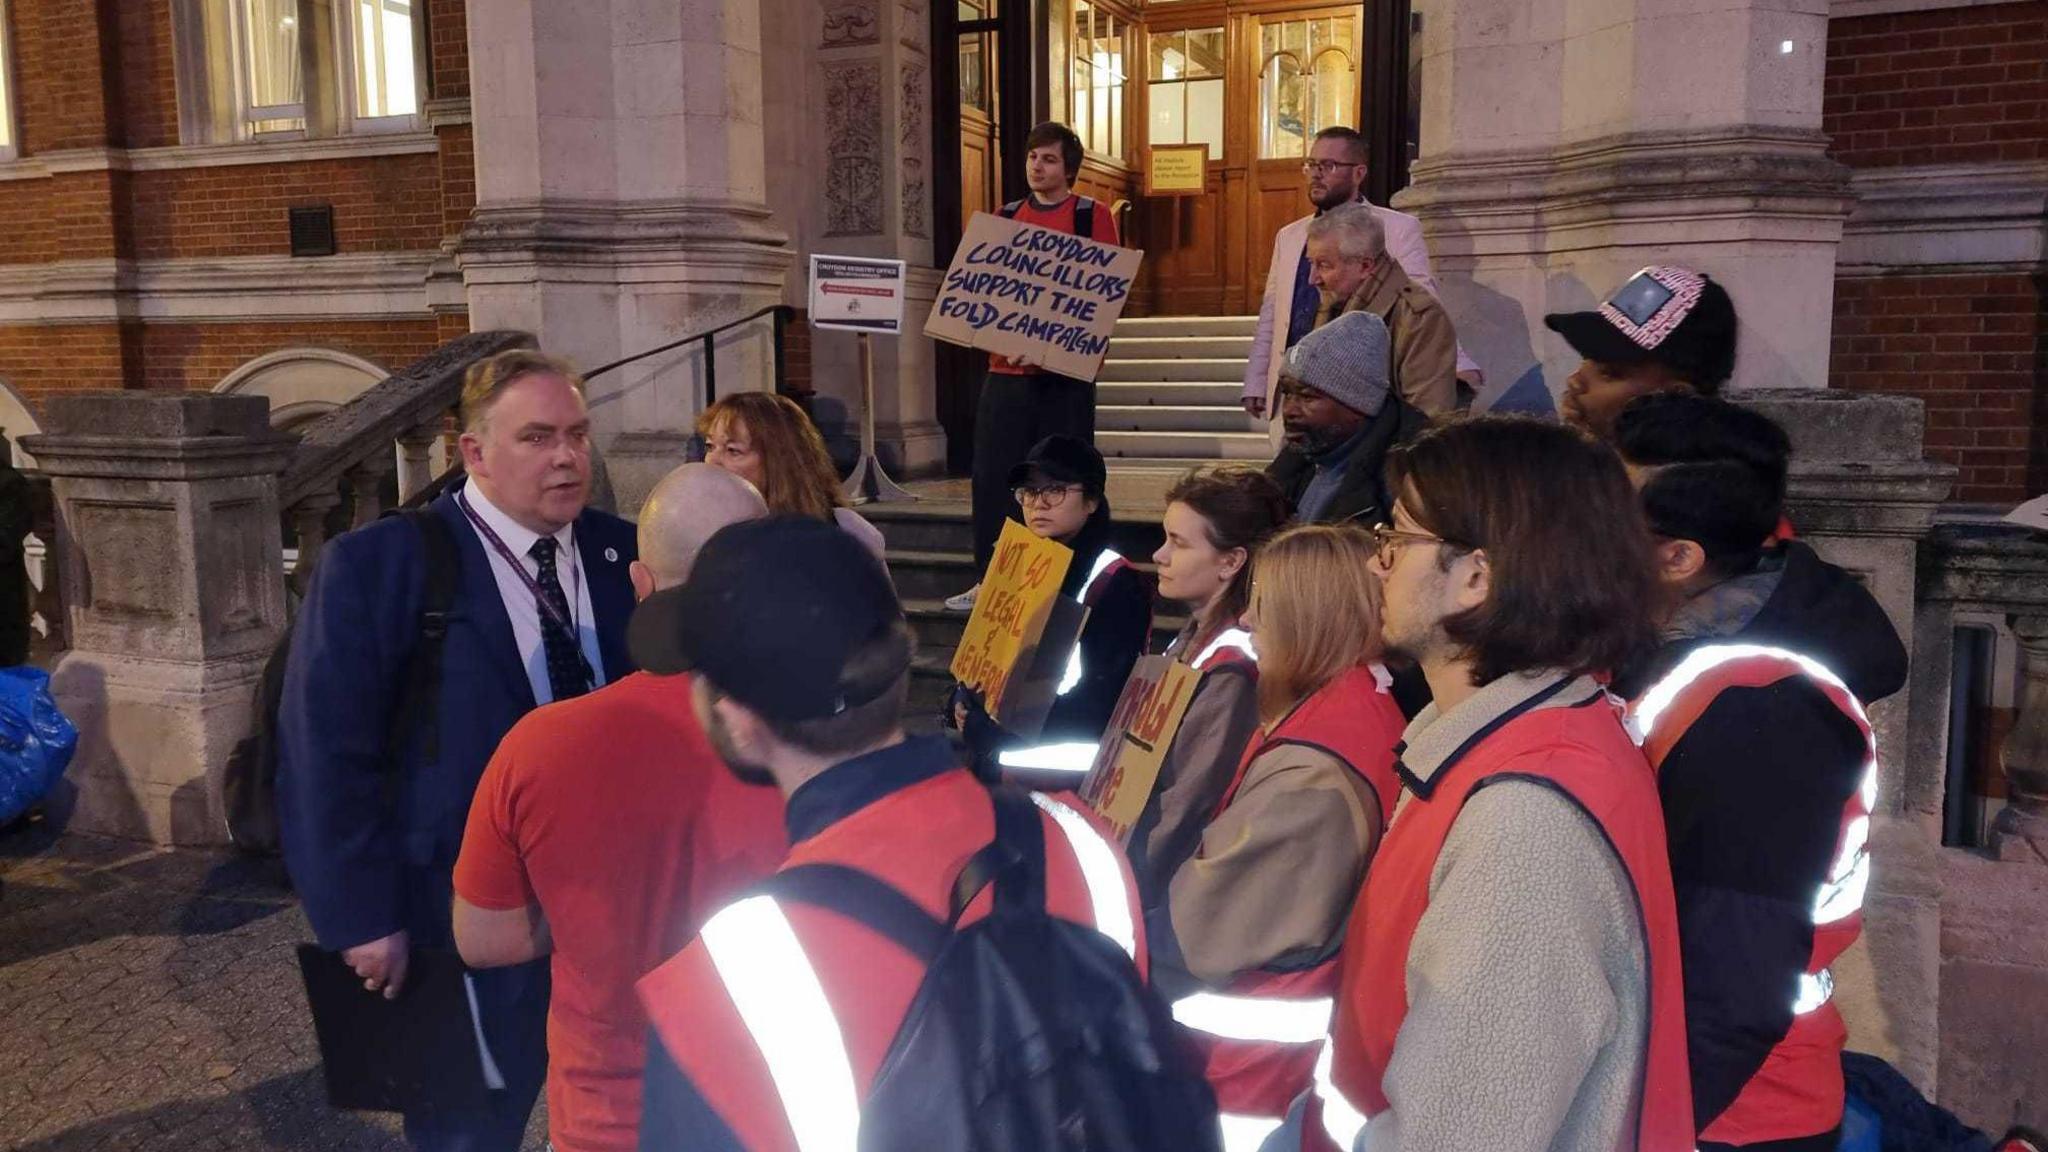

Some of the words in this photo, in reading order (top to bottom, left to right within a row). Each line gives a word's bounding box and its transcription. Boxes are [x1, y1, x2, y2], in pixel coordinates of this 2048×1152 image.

[966, 242, 1130, 302] COUNCILLORS
[1012, 228, 1117, 267] CROYDON
[947, 268, 1046, 306] SUPPORT
[1050, 291, 1098, 321] THE
[939, 297, 999, 329] FOLD
[997, 312, 1110, 355] CAMPAIGN
[996, 538, 1030, 581] NOT
[1017, 552, 1053, 592] SO
[982, 585, 1027, 638] LEGAL
[983, 625, 1000, 657] &
